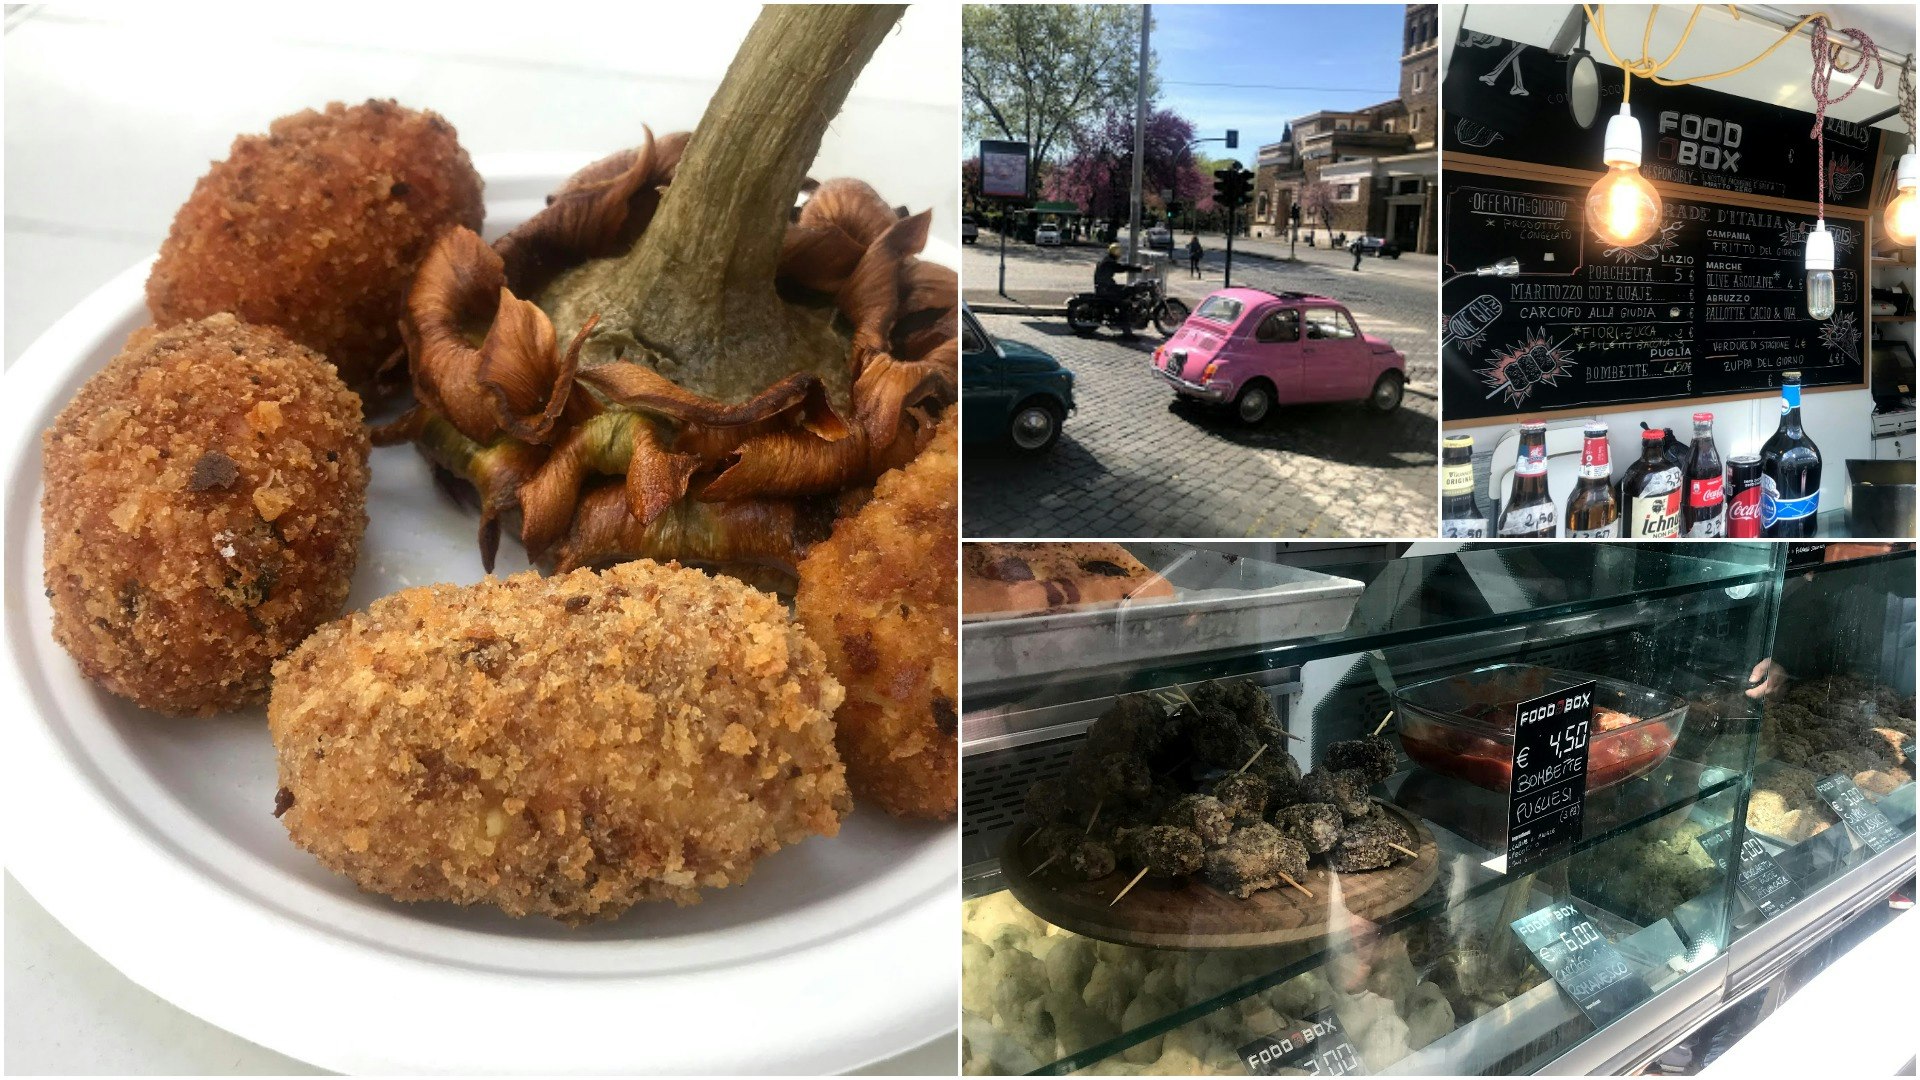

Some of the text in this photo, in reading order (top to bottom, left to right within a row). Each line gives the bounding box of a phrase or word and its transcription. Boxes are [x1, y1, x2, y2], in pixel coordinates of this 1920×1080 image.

[1659, 111, 1743, 149] FOOD
[1678, 140, 1741, 173] BOX
[1531, 198, 1568, 218] GIORNO
[1663, 203, 1784, 229] RADE D'ITALIA
[1707, 229, 1751, 240] CAMPANIA
[1713, 241, 1755, 254] FRITTO
[1661, 254, 1694, 264] LAZIO
[1706, 261, 1742, 270] MARCHE
[1674, 267, 1683, 281] 5
[1706, 273, 1729, 287] OLIVE
[1787, 280, 1794, 290] 4
[1510, 283, 1583, 300] MARITOZZO
[1706, 294, 1750, 302] ABRUZZO
[1520, 306, 1581, 319] CARCIOFO
[1588, 306, 1614, 318] ALLA
[1620, 307, 1656, 319] GIUDIA
[1706, 306, 1746, 320] PALLOTTE
[1750, 307, 1771, 320] CACIO
[1452, 310, 1480, 336] ONE
[1650, 348, 1691, 358] PUGLIA
[1723, 358, 1752, 372] ZUPPA
[1757, 357, 1774, 369] DEL
[1776, 354, 1804, 367] GIORNO
[1586, 363, 1649, 381] BOMBETTE
[1525, 512, 1554, 528] 2,50
[1520, 690, 1592, 727] FOOD BOX
[1516, 721, 1589, 769] € 4,50
[1516, 756, 1583, 793] BOMBETTE
[1816, 781, 1834, 793] FOOD
[1519, 904, 1579, 937] FOOD BOX
[1540, 946, 1556, 963] €
[1560, 921, 1600, 952] 6,00
[1248, 1017, 1338, 1070] FOOD BOX
